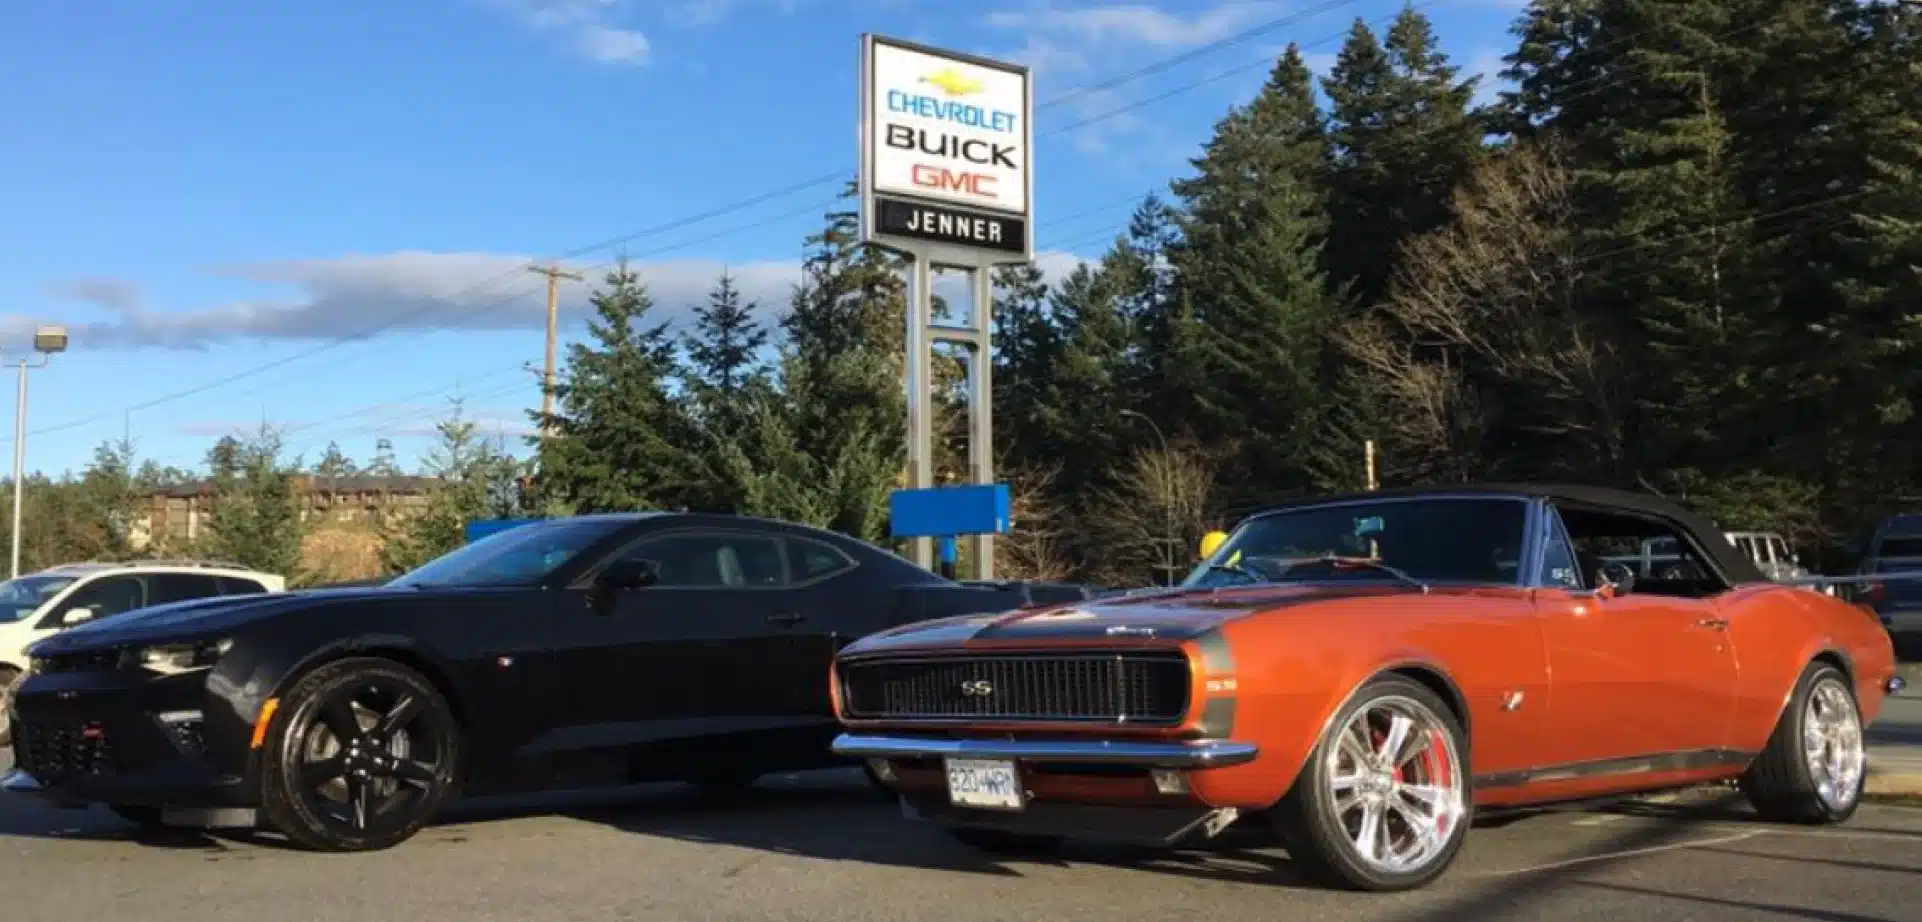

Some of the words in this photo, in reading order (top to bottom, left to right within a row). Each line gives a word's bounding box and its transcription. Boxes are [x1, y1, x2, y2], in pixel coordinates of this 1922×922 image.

[887, 90, 1016, 132] CHEVROLET
[886, 124, 1017, 168] BUICK
[912, 164, 998, 197] GMC
[906, 210, 1002, 242] JENNER
[962, 681, 992, 696] SS
